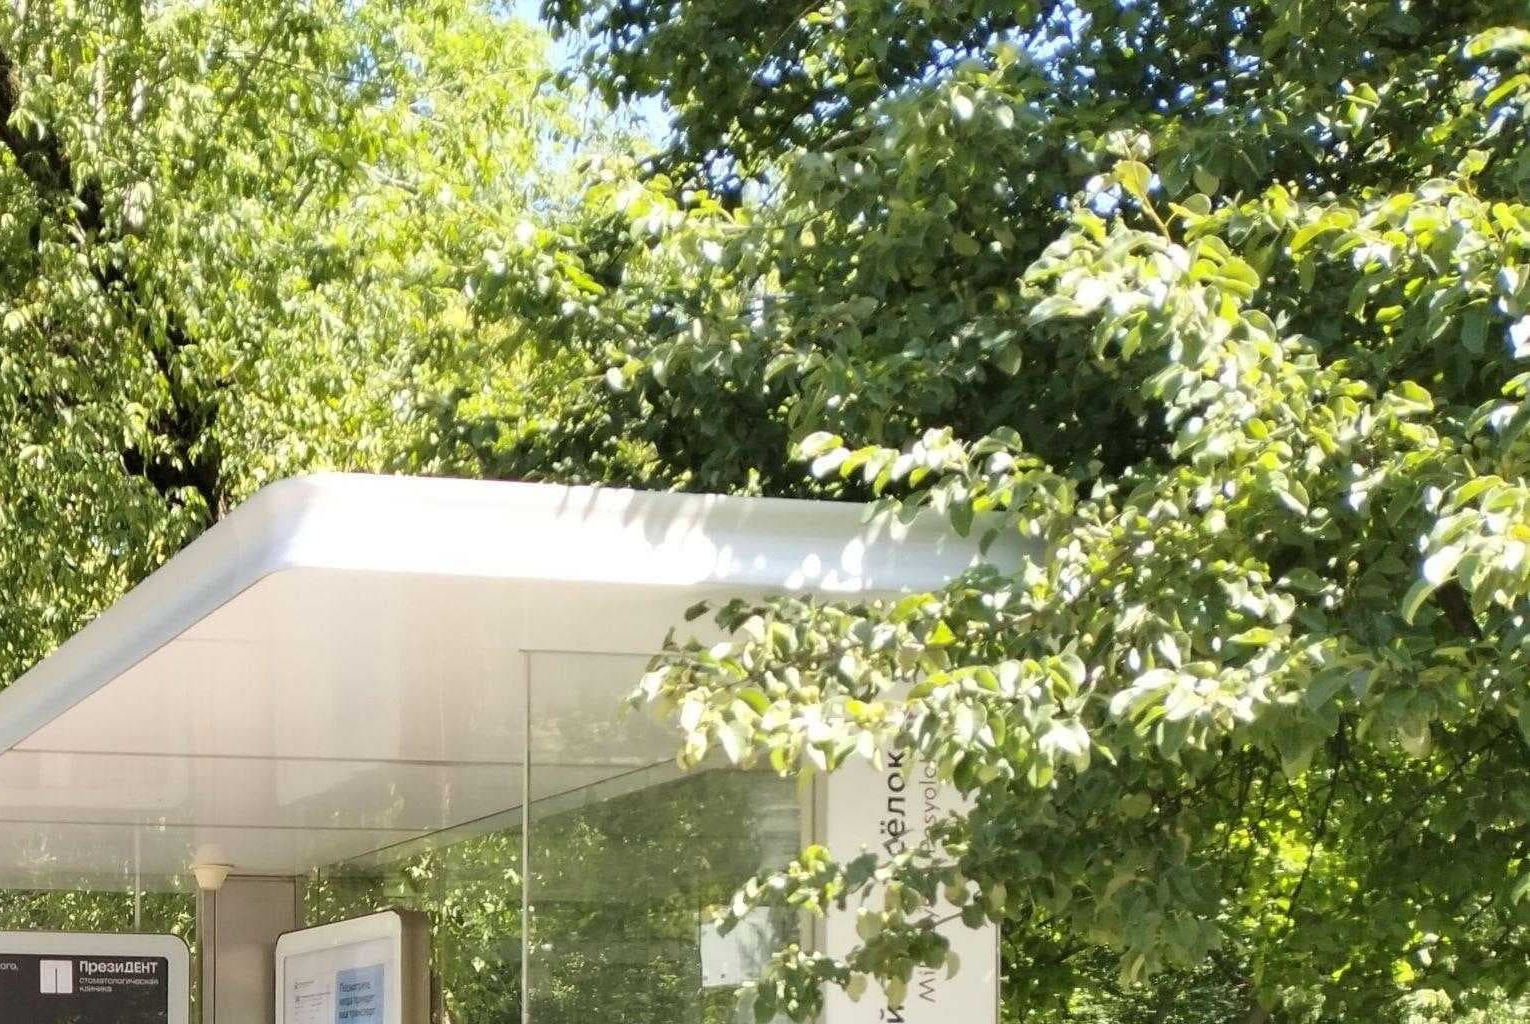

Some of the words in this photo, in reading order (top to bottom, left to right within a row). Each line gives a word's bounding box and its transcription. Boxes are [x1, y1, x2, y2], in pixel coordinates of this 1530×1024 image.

[880, 752, 907, 857] сёлок
[79, 960, 159, 975] ПрезиДЕНТ
[79, 977, 160, 986] стоматологическая
[79, 985, 113, 993] клиника
